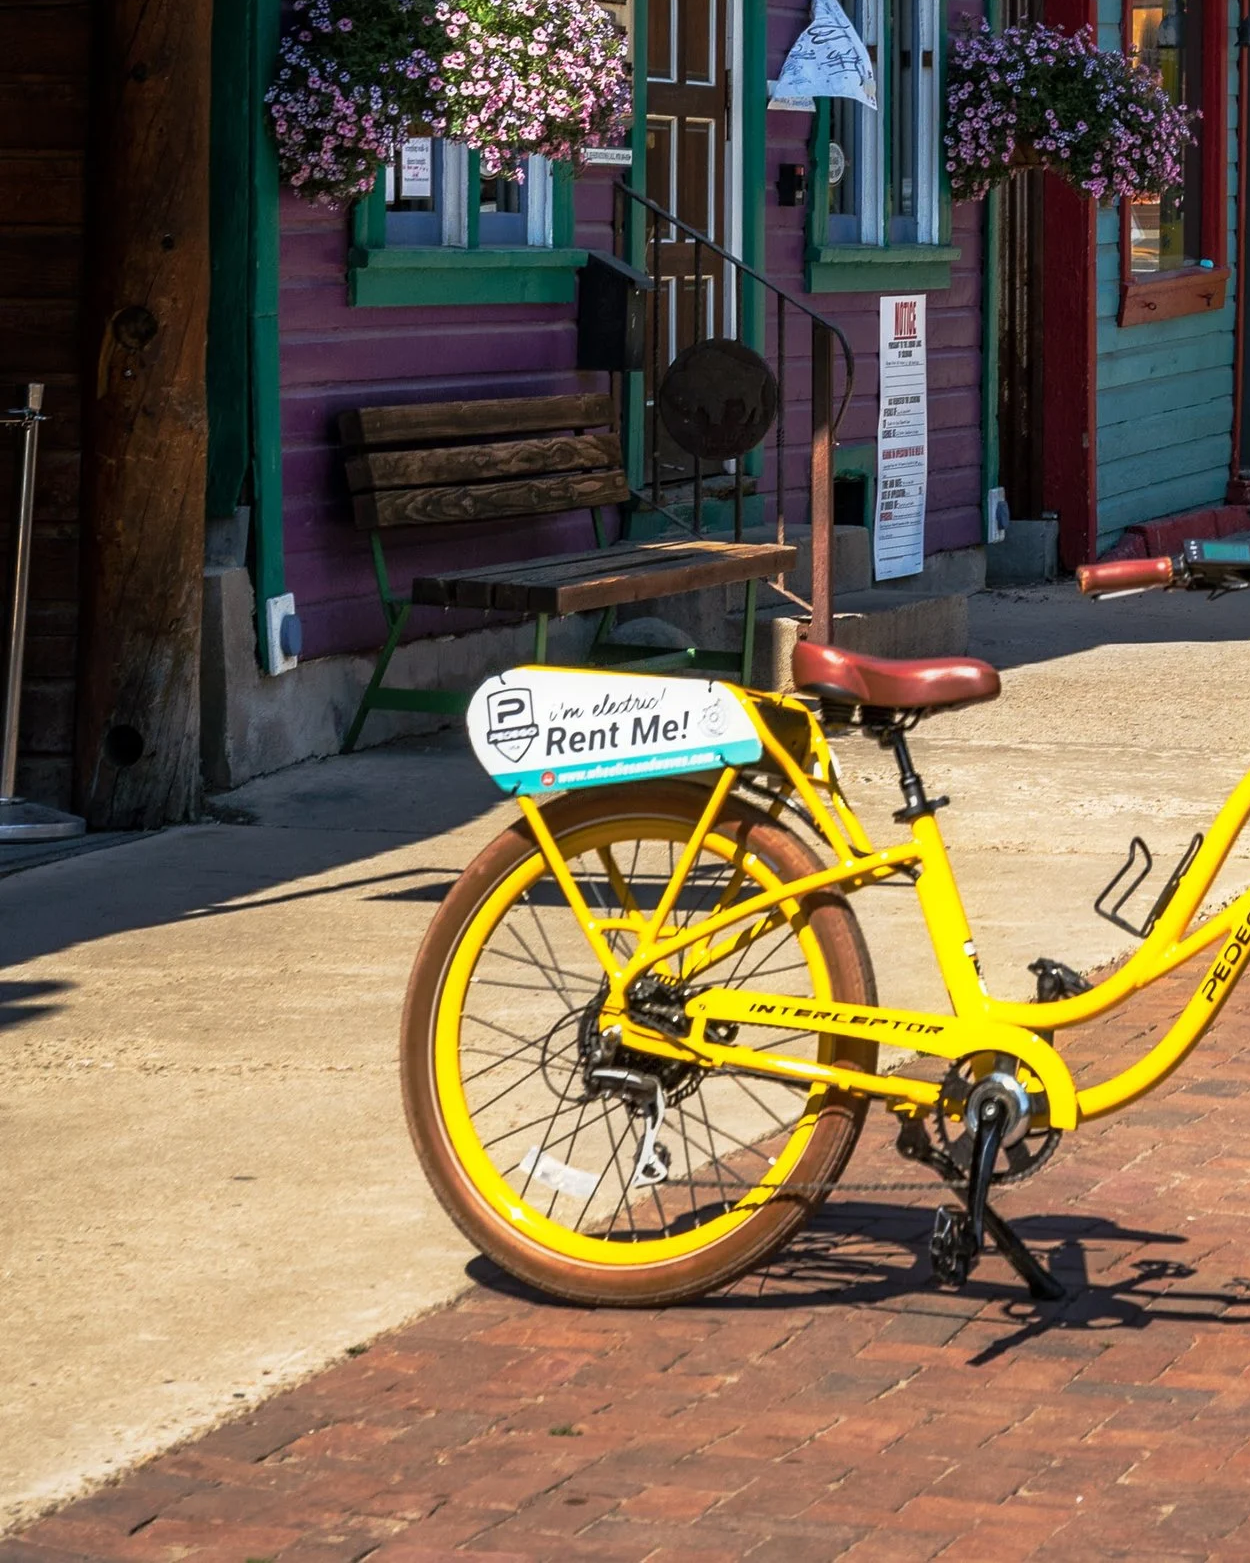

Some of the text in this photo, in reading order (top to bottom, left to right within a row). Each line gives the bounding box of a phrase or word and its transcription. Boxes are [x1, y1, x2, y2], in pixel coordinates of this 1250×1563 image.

[894, 301, 917, 336] NOTICE
[549, 687, 667, 723] i'm electric!
[546, 710, 690, 757] Rent Me!
[749, 1003, 945, 1035] INTERCEPTOR
